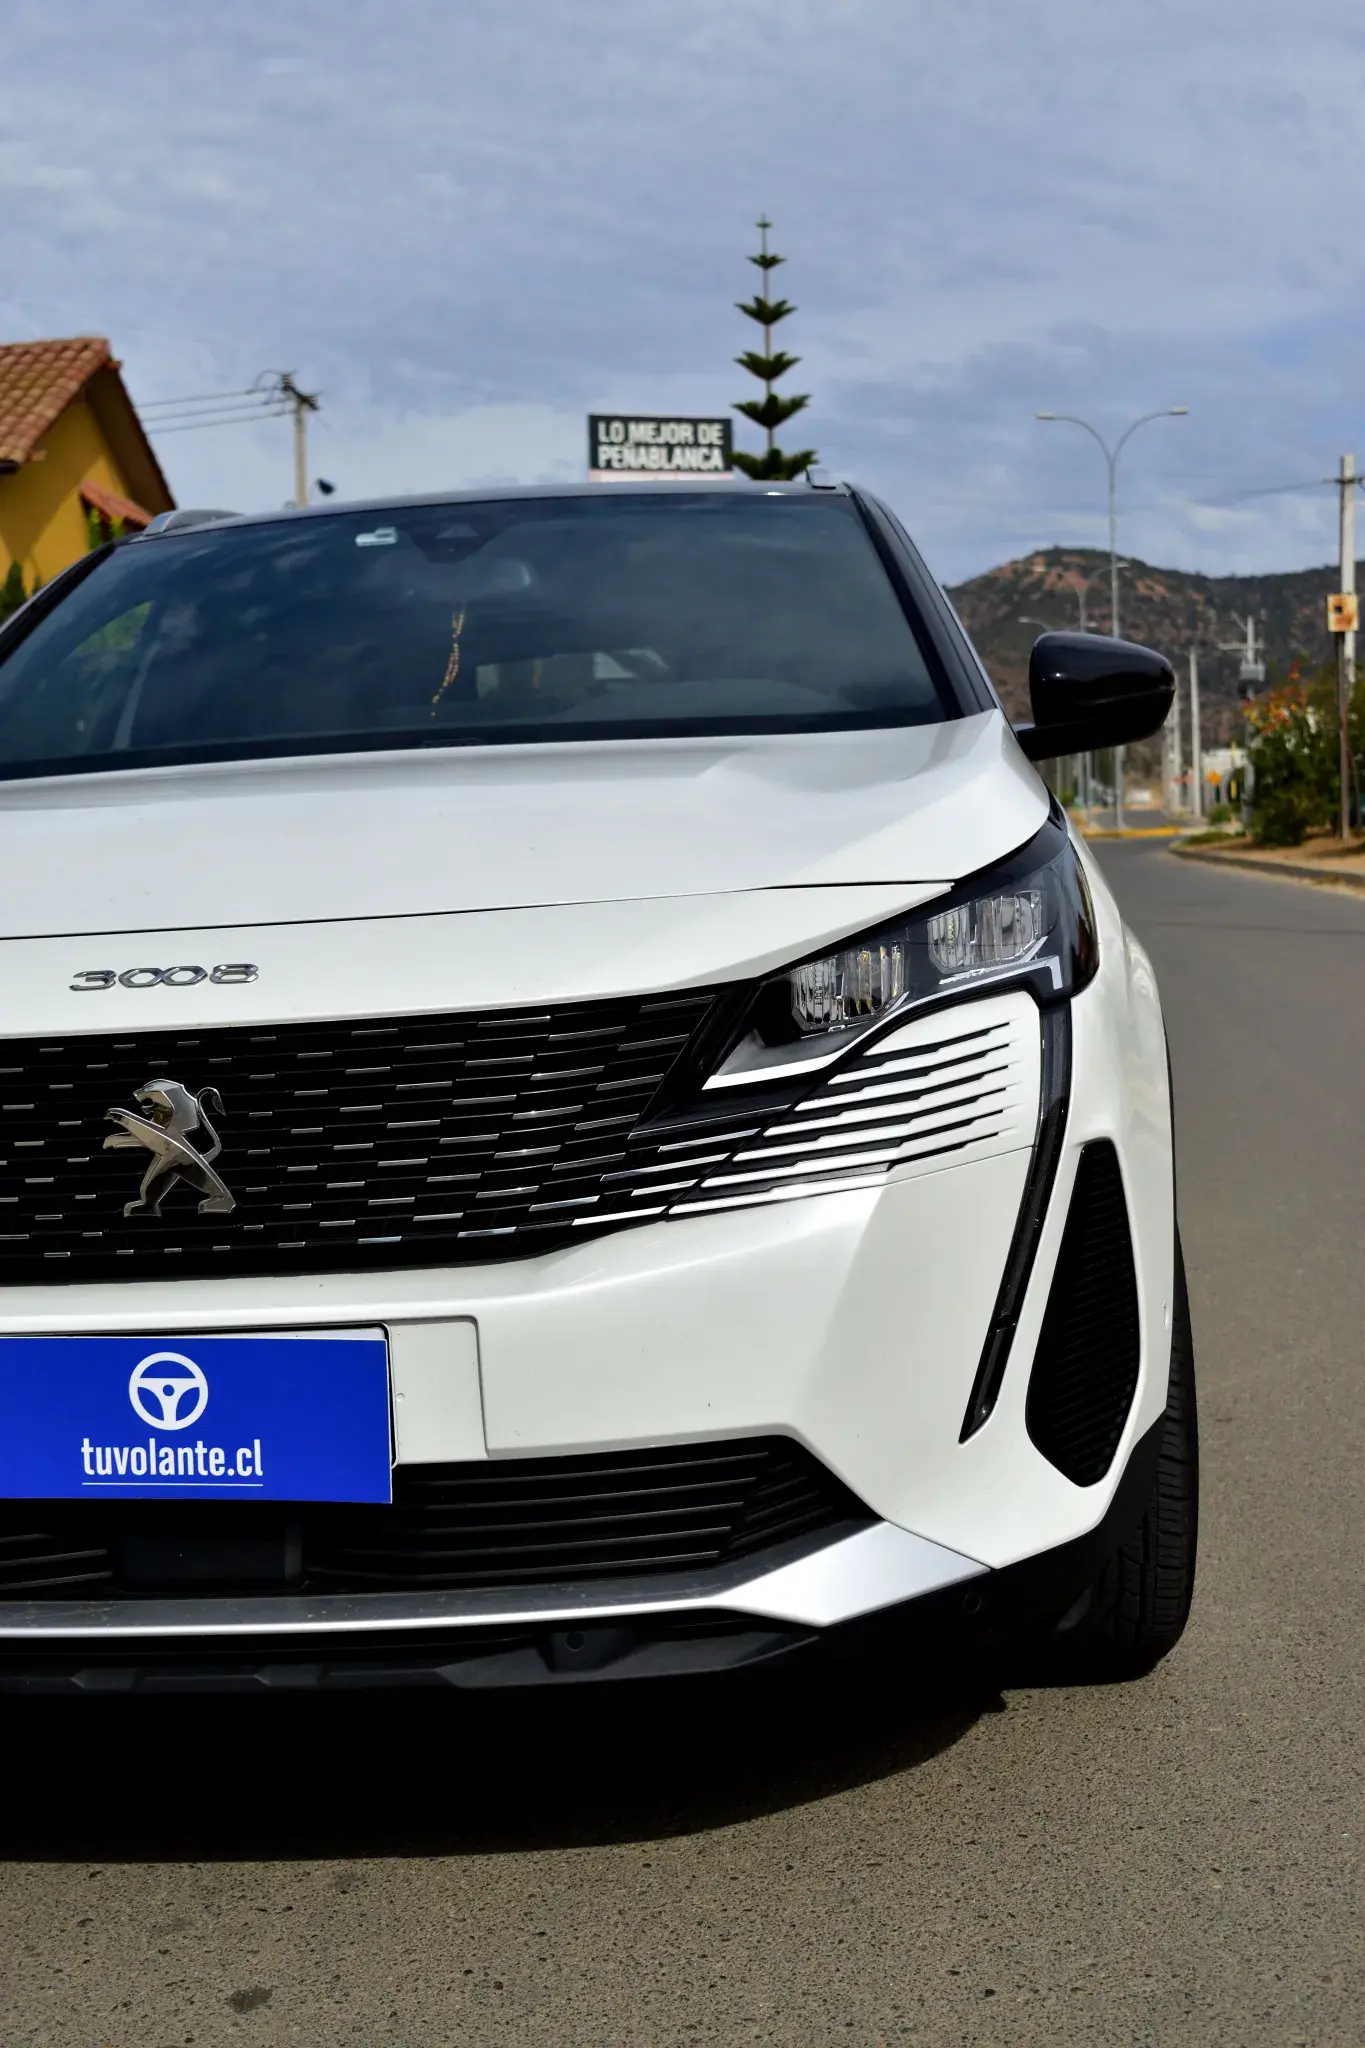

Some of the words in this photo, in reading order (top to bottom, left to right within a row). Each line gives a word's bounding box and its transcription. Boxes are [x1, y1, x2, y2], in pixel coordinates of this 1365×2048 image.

[598, 420, 625, 443] LO
[628, 421, 694, 445] MEJOR
[697, 423, 723, 445] DE
[69, 963, 259, 991] 3008
[81, 1438, 263, 1477] tuvolante.cl
